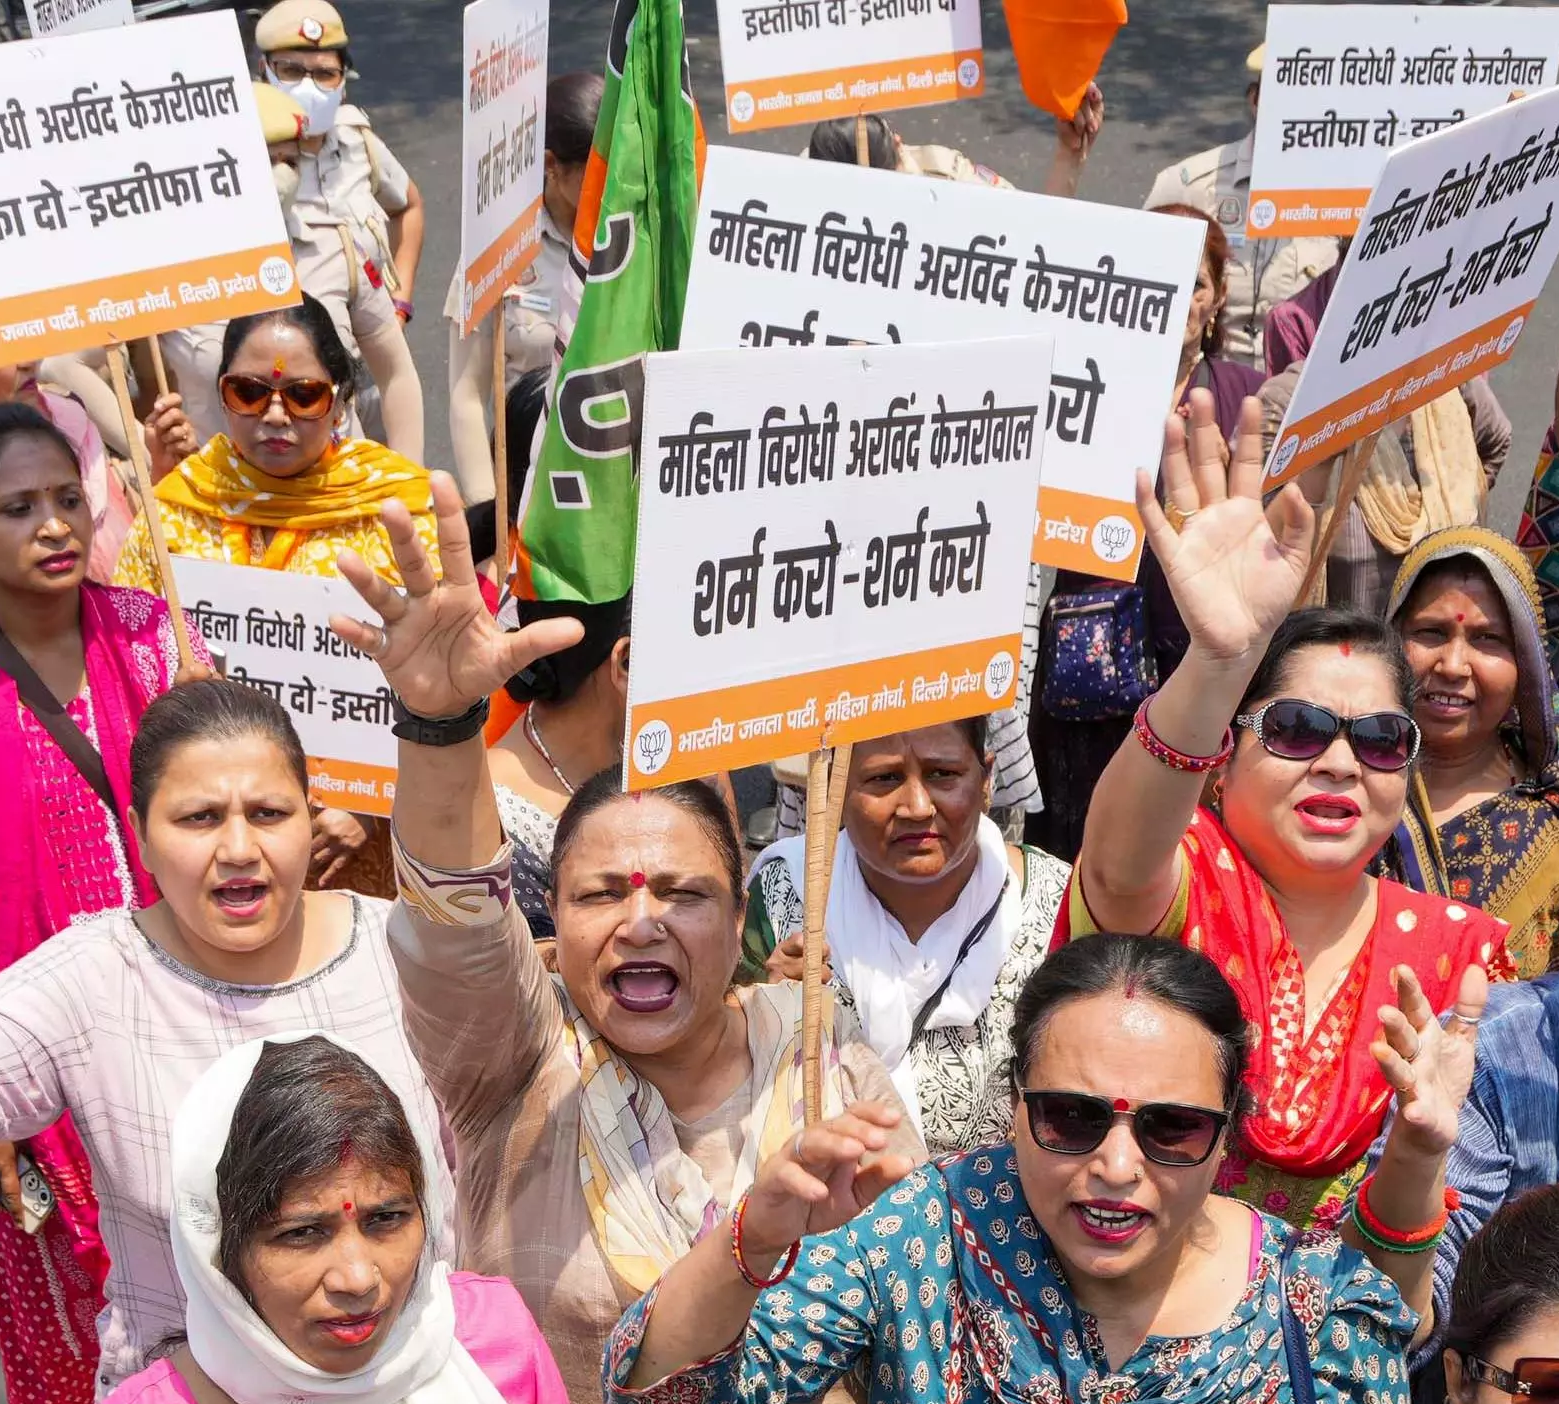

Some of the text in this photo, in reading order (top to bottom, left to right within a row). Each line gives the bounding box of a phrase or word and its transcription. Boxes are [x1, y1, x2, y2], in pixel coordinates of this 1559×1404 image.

[36, 82, 118, 143] अरविंद
[119, 71, 239, 129] केजरीवाल
[1276, 44, 1547, 86] महिला विरोधी अरविंद केजरीवाल
[203, 148, 242, 197] दो
[1282, 109, 1370, 151] इस्तीफा
[1358, 188, 1429, 261] महिला
[1417, 153, 1490, 237] विरोधी
[1475, 128, 1544, 209] अरविंद
[709, 199, 1178, 334] महिला विरोधी अरविंद केजरीवाल
[1340, 266, 1411, 363] शर्म
[1493, 201, 1553, 286] करो
[658, 390, 1038, 497] महिला विरोधी अरविंद केजरीवाल
[693, 526, 766, 637] शर्म
[929, 501, 991, 597] करो
[678, 717, 735, 752] भारतीय
[737, 713, 784, 740] जनता
[824, 691, 869, 721] महिला
[911, 671, 949, 703] दिल्ली
[951, 668, 982, 697] प्रदेश
